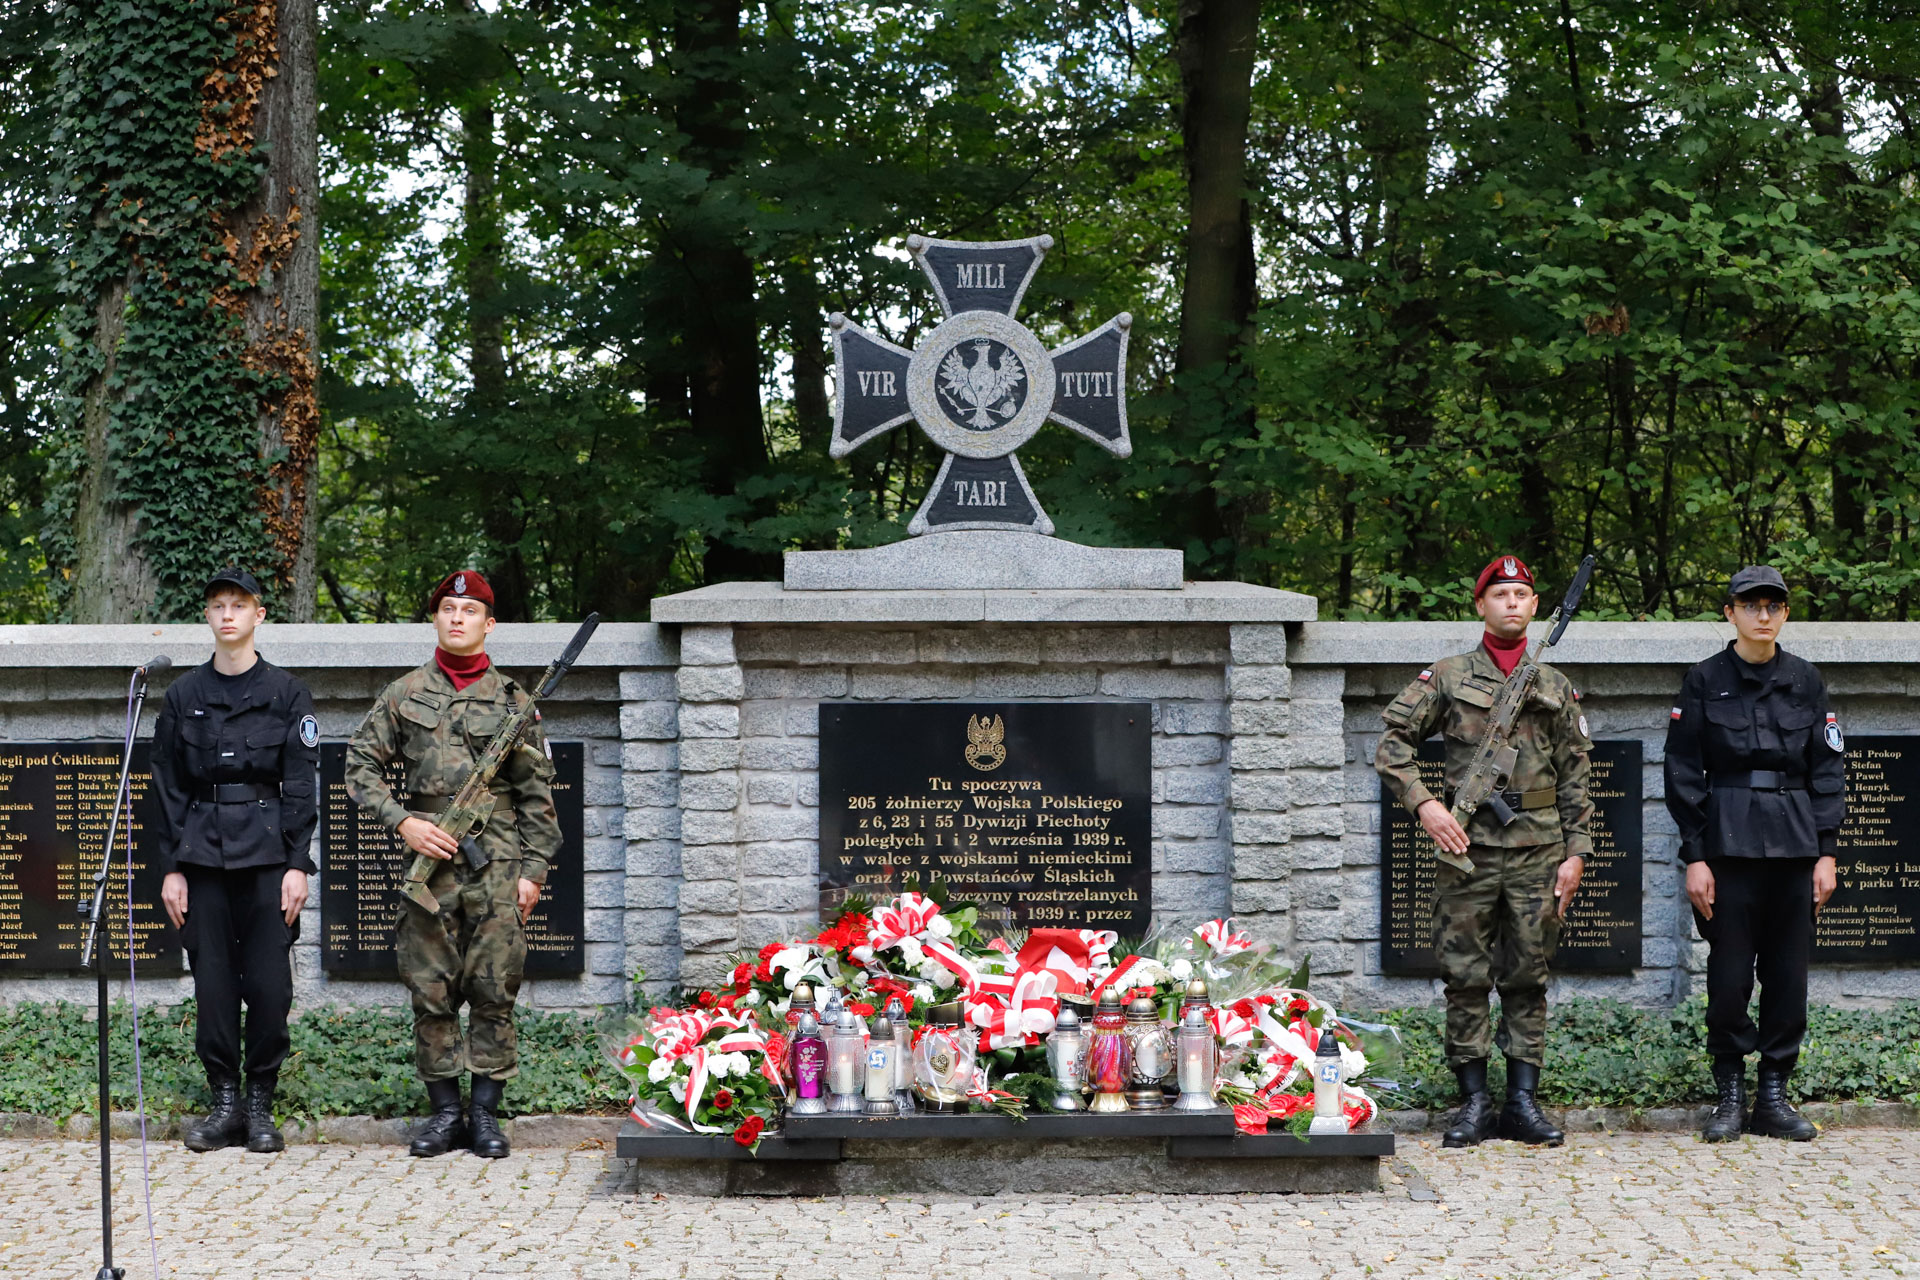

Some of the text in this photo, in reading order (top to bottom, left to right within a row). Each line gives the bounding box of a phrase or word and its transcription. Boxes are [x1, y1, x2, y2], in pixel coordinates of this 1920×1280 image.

[956, 263, 1006, 290] MILI
[857, 370, 1113, 398] VIR TUTI
[954, 480, 1008, 506] TARI
[1867, 750, 1902, 759] Prokop
[26, 752, 120, 768] pod Ćwiklicami
[1851, 761, 1882, 769] Stefan
[78, 773, 111, 781] Drzyzga
[929, 777, 1042, 793] Tu spoczywa
[1855, 783, 1890, 792] Henryk
[848, 795, 1123, 812] 205 żołnierzy Wojska Polskiego
[1847, 805, 1886, 814] Tadeusz
[78, 812, 101, 820] Gorol
[1858, 816, 1891, 824] Roman
[56, 822, 109, 832] kpr. Grodek
[859, 814, 1111, 831] z 6, 23 i 55 Dywizji Piechoty
[1867, 827, 1884, 835] Jan
[6, 833, 27, 842] Szaja
[78, 832, 103, 841] Grycz
[843, 832, 1126, 850] poległych 1 i 2 września 1939 r.
[78, 842, 103, 851] Grycz
[1600, 840, 1615, 848] Jan
[839, 851, 1133, 868] w walce z wojskami niemieckimi
[1855, 860, 1890, 876] Śląscy
[1895, 862, 1899, 873] i
[855, 866, 1115, 886] oraz 20 Powstańców Śląskich
[1392, 871, 1409, 880] kpr.
[106, 882, 126, 890] Piotr
[1392, 881, 1409, 890] kpr.
[1859, 878, 1894, 890] parku
[1018, 888, 1139, 904] rozstrzelanych
[1587, 889, 1610, 897] Józef
[118, 902, 153, 910] Saomon
[1862, 905, 1898, 914] Andrzej
[1027, 906, 1133, 923] 1939 r. przez
[1392, 911, 1409, 920] kpr.
[1816, 916, 1866, 925] Folwarczny
[1, 922, 23, 930] Józef
[1577, 930, 1609, 938] Andrzej
[1816, 926, 1916, 937] Folwarczny Franciszek
[330, 934, 352, 942] ppor.
[124, 942, 146, 950] Jzef
[1568, 940, 1612, 948] Franciszek
[1816, 938, 1888, 948] Folwarczny Jan
